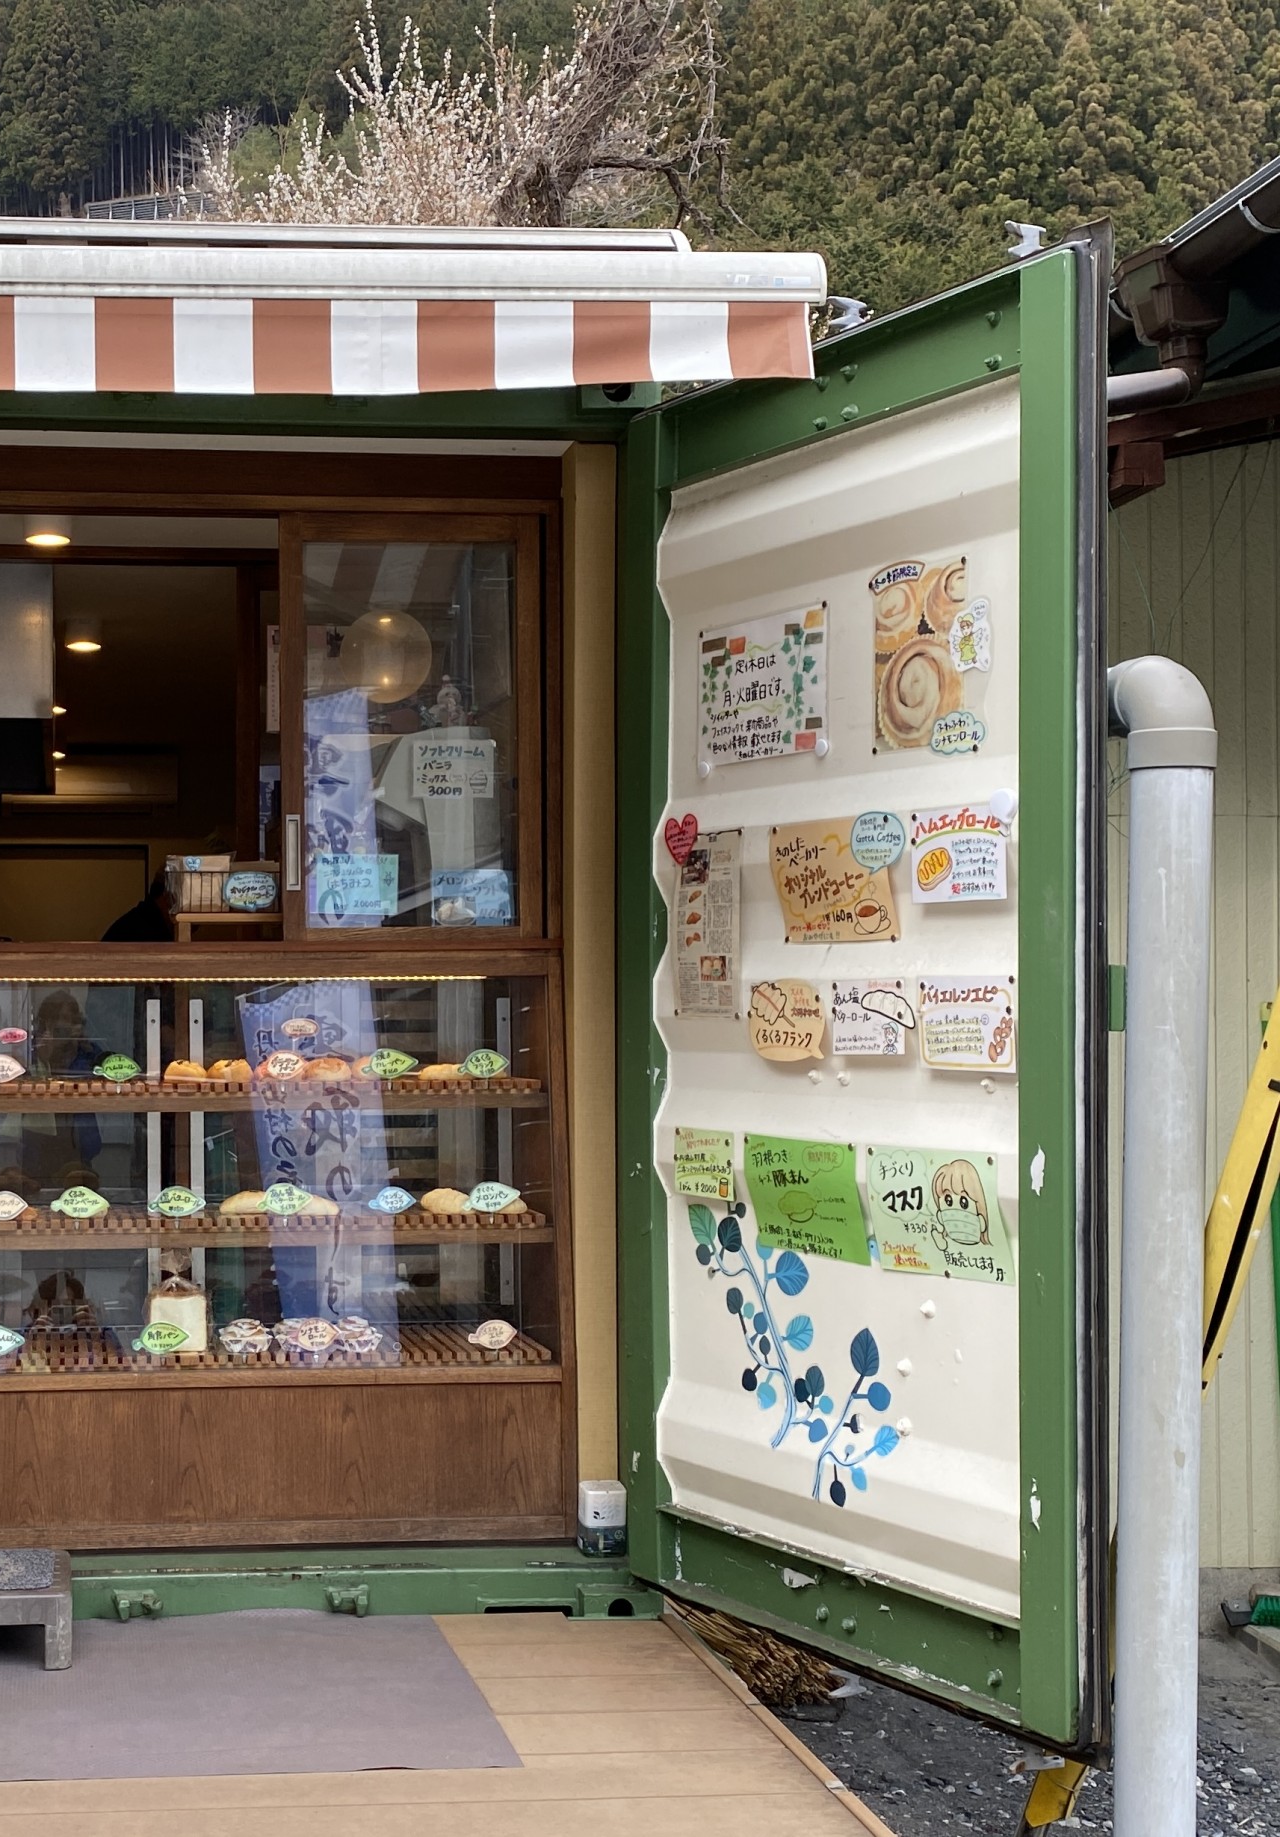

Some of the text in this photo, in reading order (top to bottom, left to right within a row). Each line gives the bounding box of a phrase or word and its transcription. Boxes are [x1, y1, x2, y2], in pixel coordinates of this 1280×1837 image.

[734, 654, 776, 676] 定休日は
[934, 730, 980, 747] シナモンロール
[418, 745, 485, 757] ソフトクリーム
[423, 760, 452, 770] バニラ
[428, 785, 463, 796] 300円
[914, 807, 1002, 839] ハムエッグロール
[784, 864, 826, 895] オリジナル
[799, 871, 865, 909] ブレンドコーヒー
[833, 986, 860, 1006] あん塩
[921, 985, 998, 1004] バイエルンエピ
[755, 1030, 813, 1049] くるくるフランク
[751, 1149, 788, 1168] 羽根つき
[879, 1160, 914, 1181] 手づくり
[882, 1185, 923, 1213] マスク
[904, 1223, 928, 1233] ¥330
[944, 1251, 995, 1274] 販売してます
